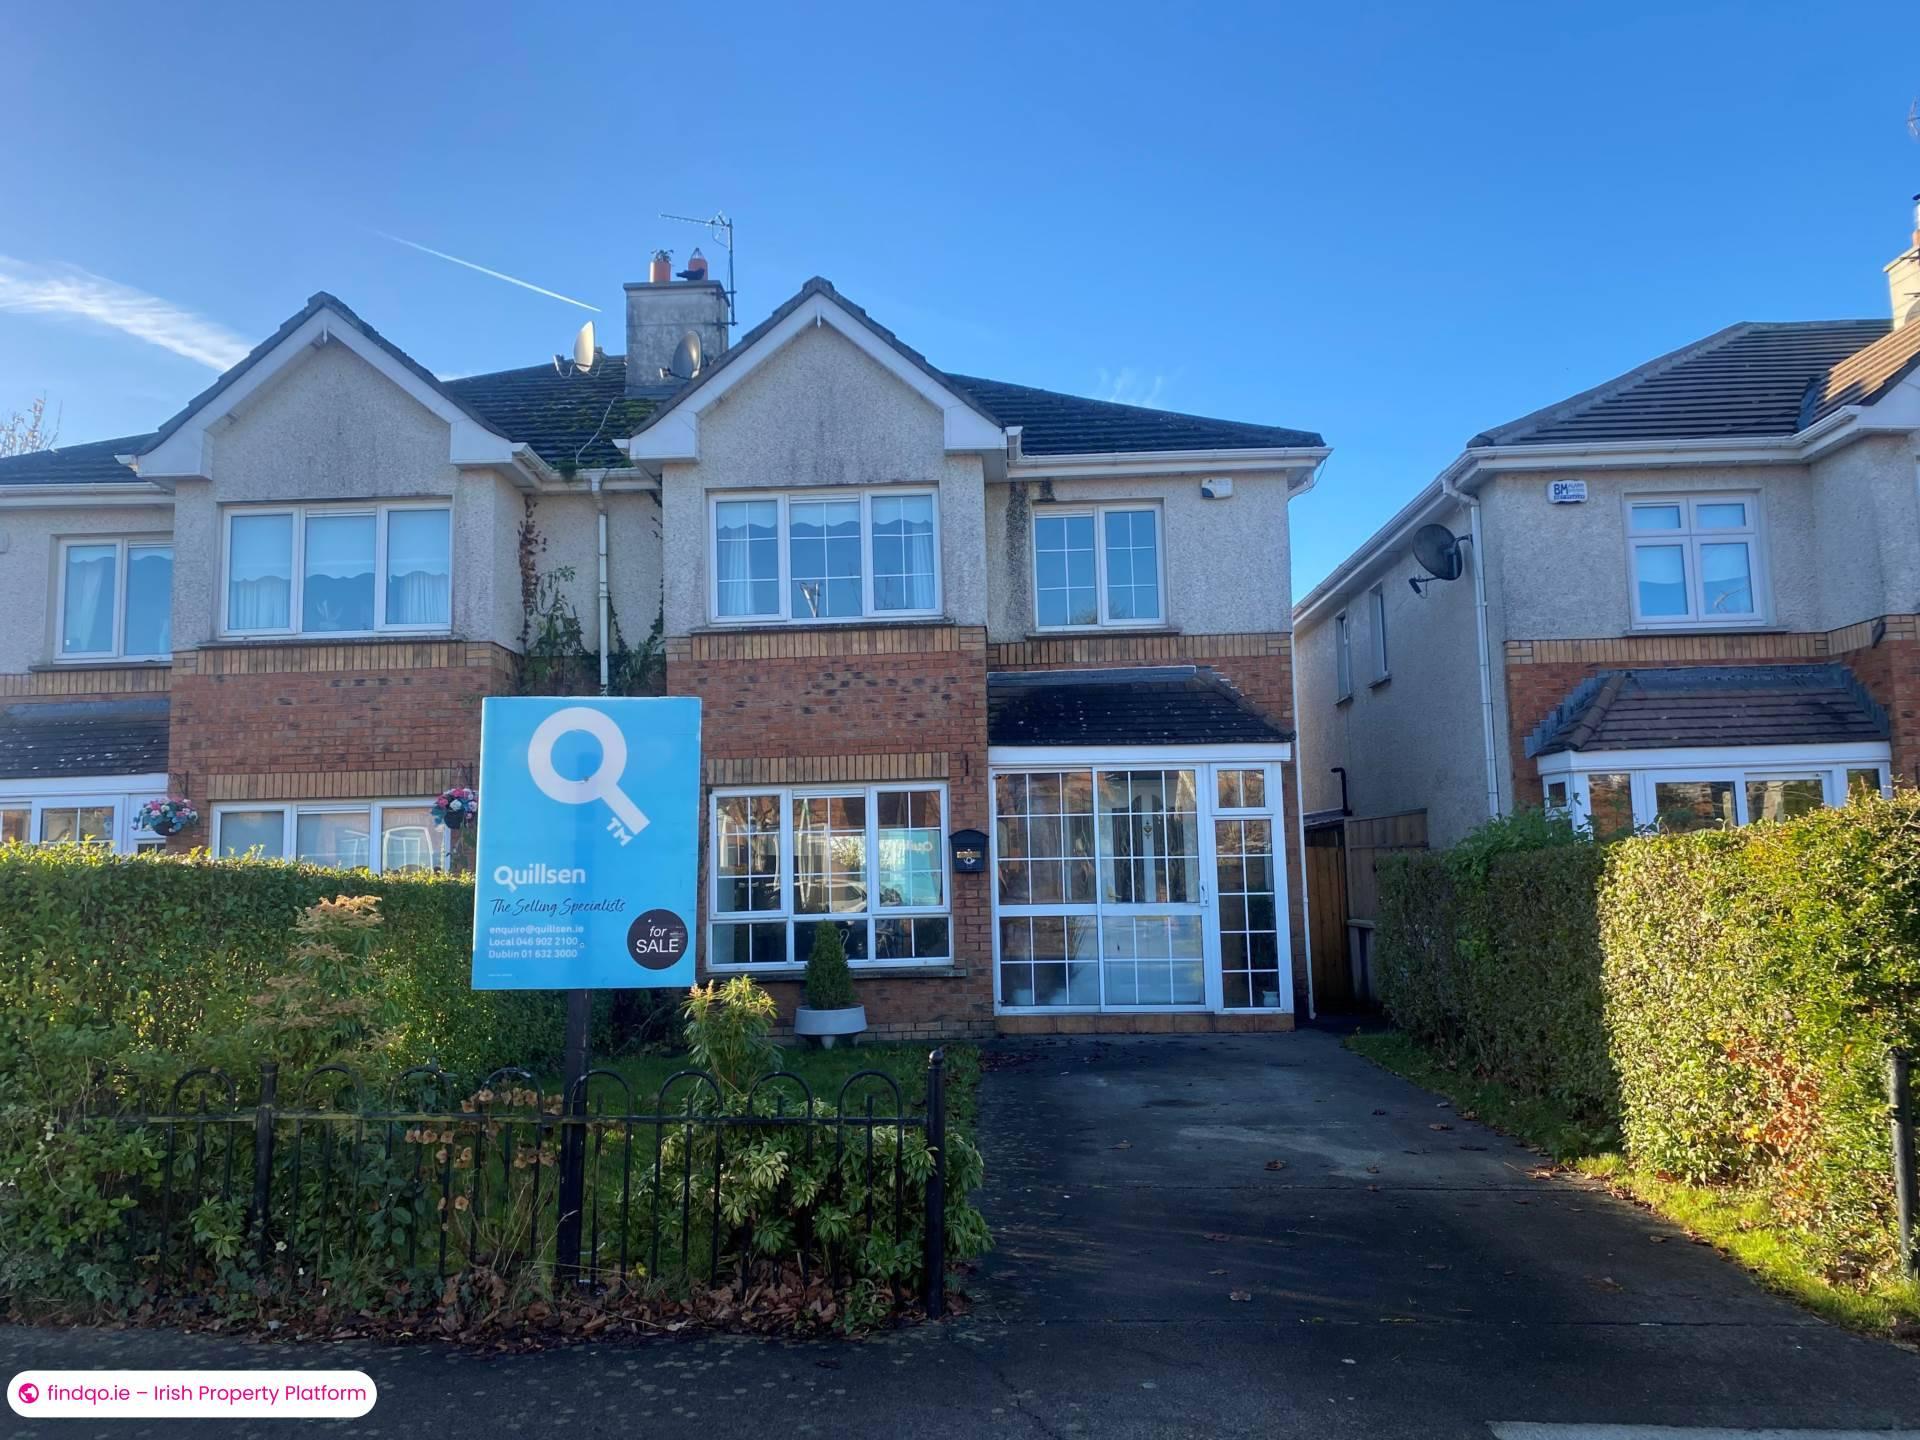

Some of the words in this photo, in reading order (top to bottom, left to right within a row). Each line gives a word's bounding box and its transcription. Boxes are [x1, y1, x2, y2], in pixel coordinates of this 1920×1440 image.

[1554, 483, 1568, 495] BM
[494, 864, 586, 892] Quillsen
[490, 899, 511, 916] The
[512, 898, 558, 917] Selling
[559, 898, 626, 916] Specialists
[489, 925, 584, 935] enquire@quillsen.ie
[649, 926, 667, 937] for
[489, 938, 514, 946] Local
[516, 938, 534, 946] 046
[535, 937, 553, 946] 902
[555, 937, 578, 946] 2100
[636, 939, 679, 953] SALE
[488, 950, 520, 958] Dublin
[521, 950, 532, 958] 01
[535, 950, 552, 958] 632
[554, 949, 578, 958] 3000
